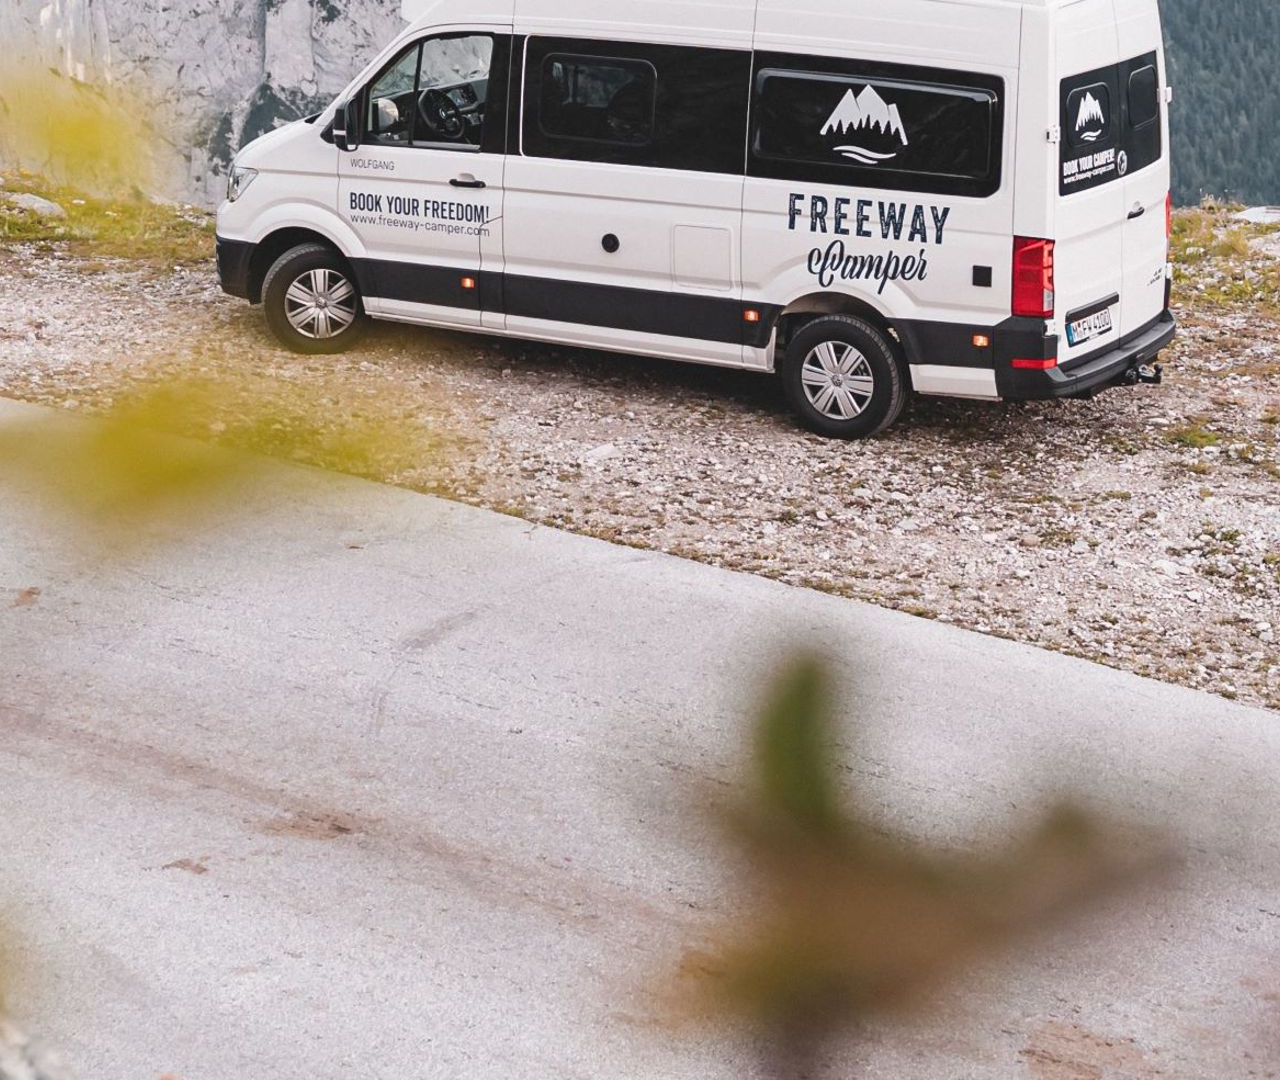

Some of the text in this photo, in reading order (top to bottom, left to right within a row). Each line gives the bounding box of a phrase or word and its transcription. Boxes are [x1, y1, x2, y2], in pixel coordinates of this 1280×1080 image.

[350, 158, 395, 171] WOLFGANG
[1063, 159, 1078, 176] BOOK
[1079, 155, 1093, 171] YOUR
[350, 192, 490, 223] BOOK YOUR FREEDOM!
[788, 193, 950, 245] FREEWAY
[350, 214, 490, 236] www.freeway-camper.com
[807, 239, 928, 295] Camper
